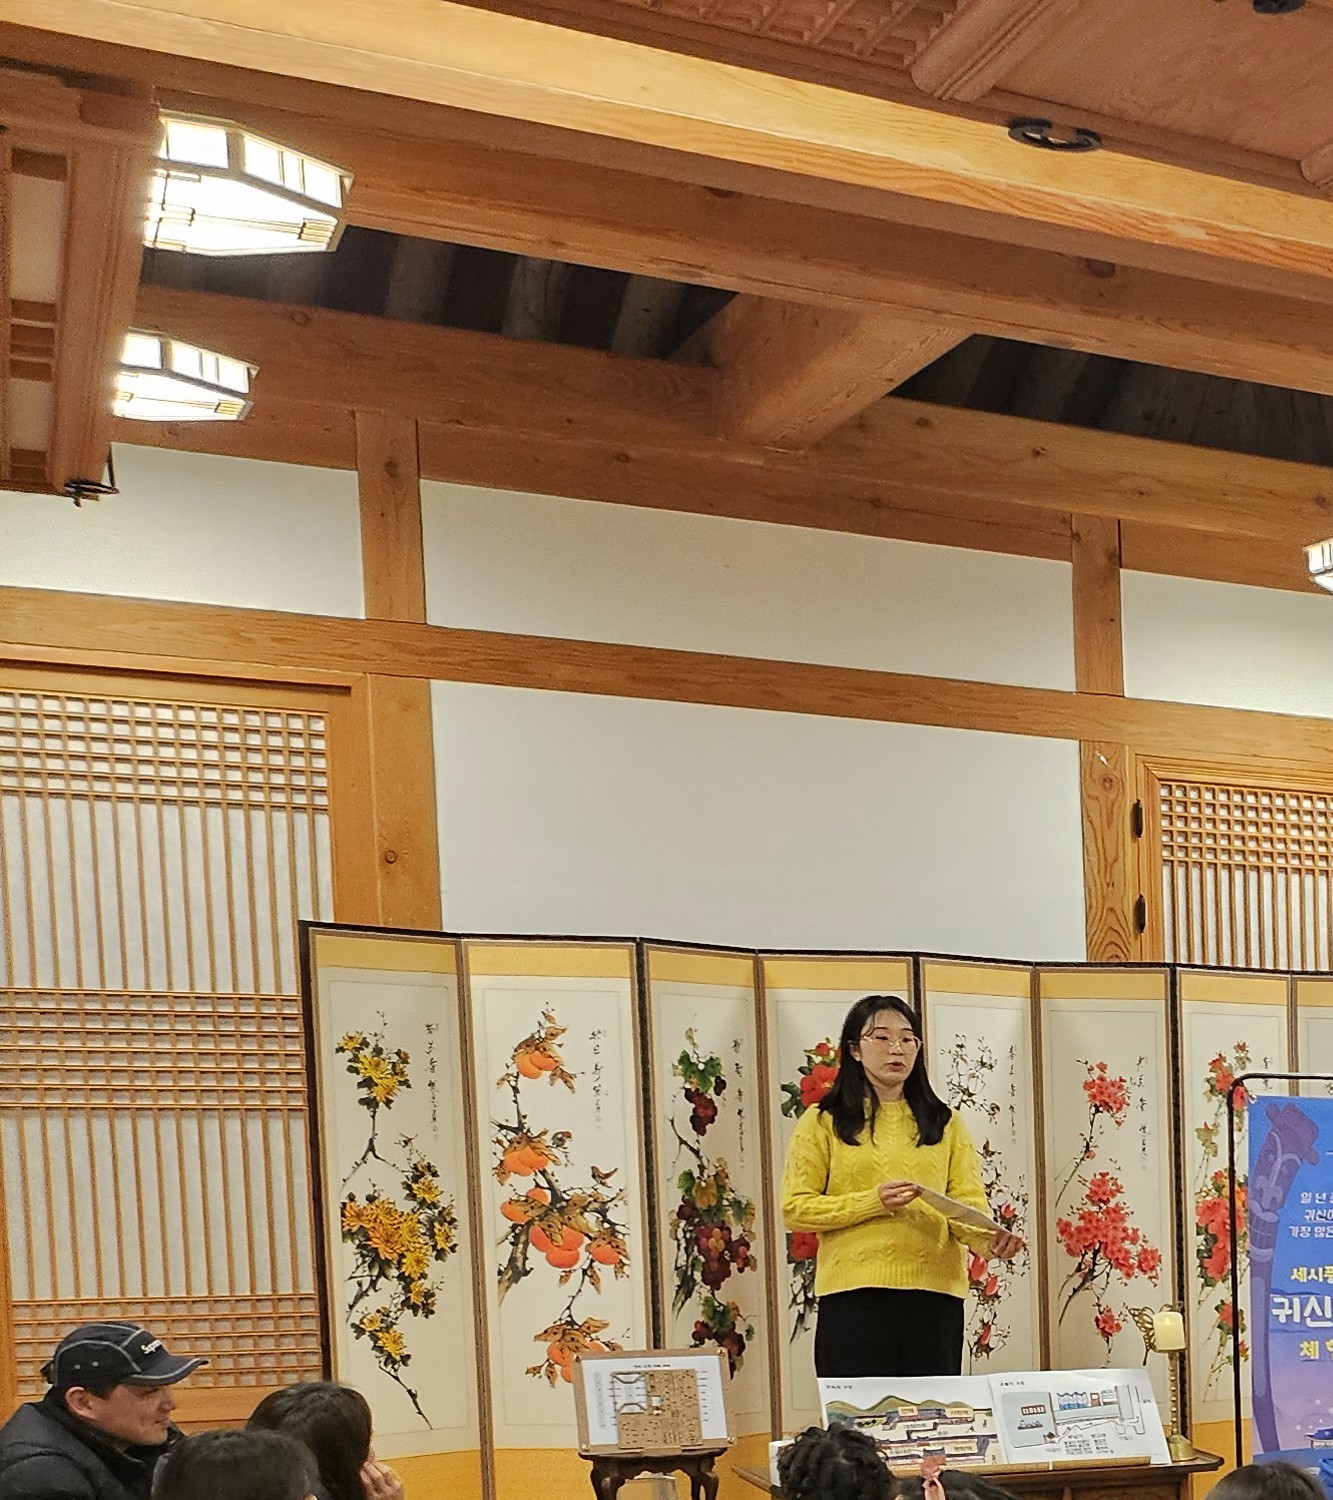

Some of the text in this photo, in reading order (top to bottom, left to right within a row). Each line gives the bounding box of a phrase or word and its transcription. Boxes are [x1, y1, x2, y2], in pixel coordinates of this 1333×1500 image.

[1300, 1192, 1311, 1204] 일
[1316, 1192, 1327, 1204] 년
[1289, 1226, 1311, 1238] 가장
